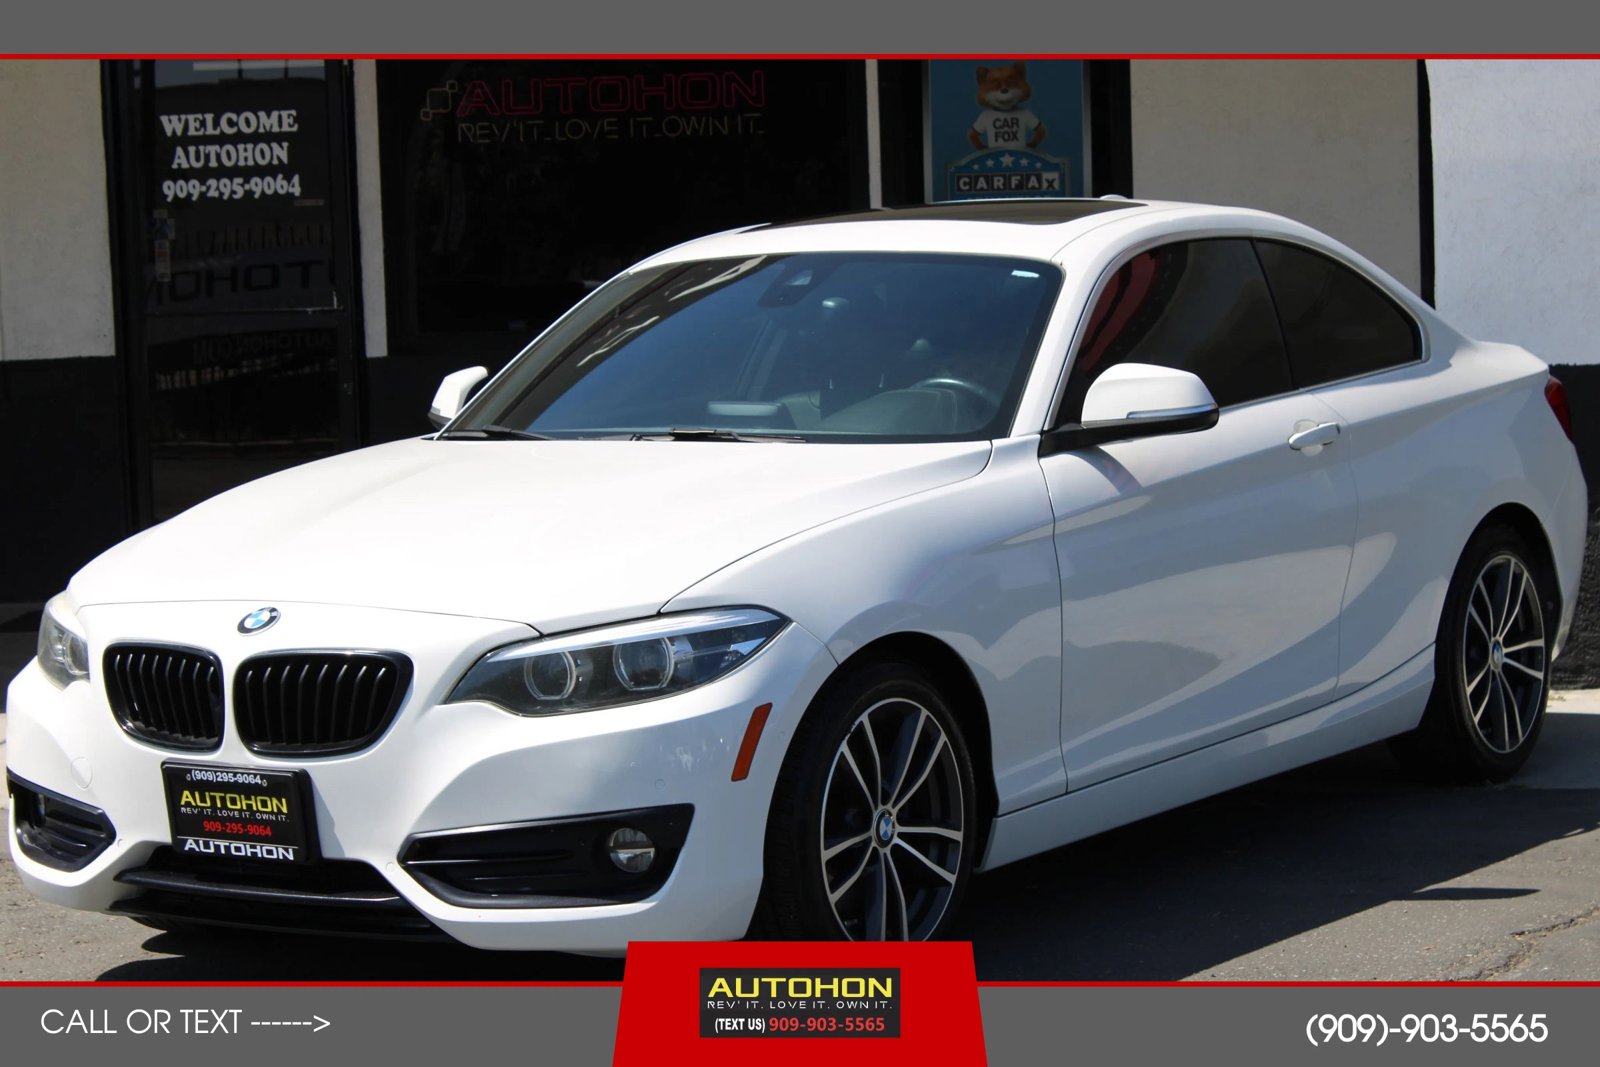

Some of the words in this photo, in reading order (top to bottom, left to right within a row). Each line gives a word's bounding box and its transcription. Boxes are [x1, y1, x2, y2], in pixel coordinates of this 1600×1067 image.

[456, 70, 765, 118] AUTOHON
[160, 109, 299, 137] WELCOME
[555, 118, 619, 141] LOVE
[662, 115, 728, 137] OWN
[992, 117, 1020, 130] CAR
[994, 130, 1020, 143] FOX
[171, 142, 289, 169] AUTOHON
[162, 173, 302, 202] 909-295-9064
[958, 174, 1058, 191] CARFAX
[191, 769, 262, 785] (909)295-9064
[180, 790, 288, 814] AUTOHON
[217, 810, 240, 818] LOVE
[255, 813, 276, 821] OWN
[203, 821, 272, 836] 909-295-9064
[184, 839, 295, 861] AUTOHON
